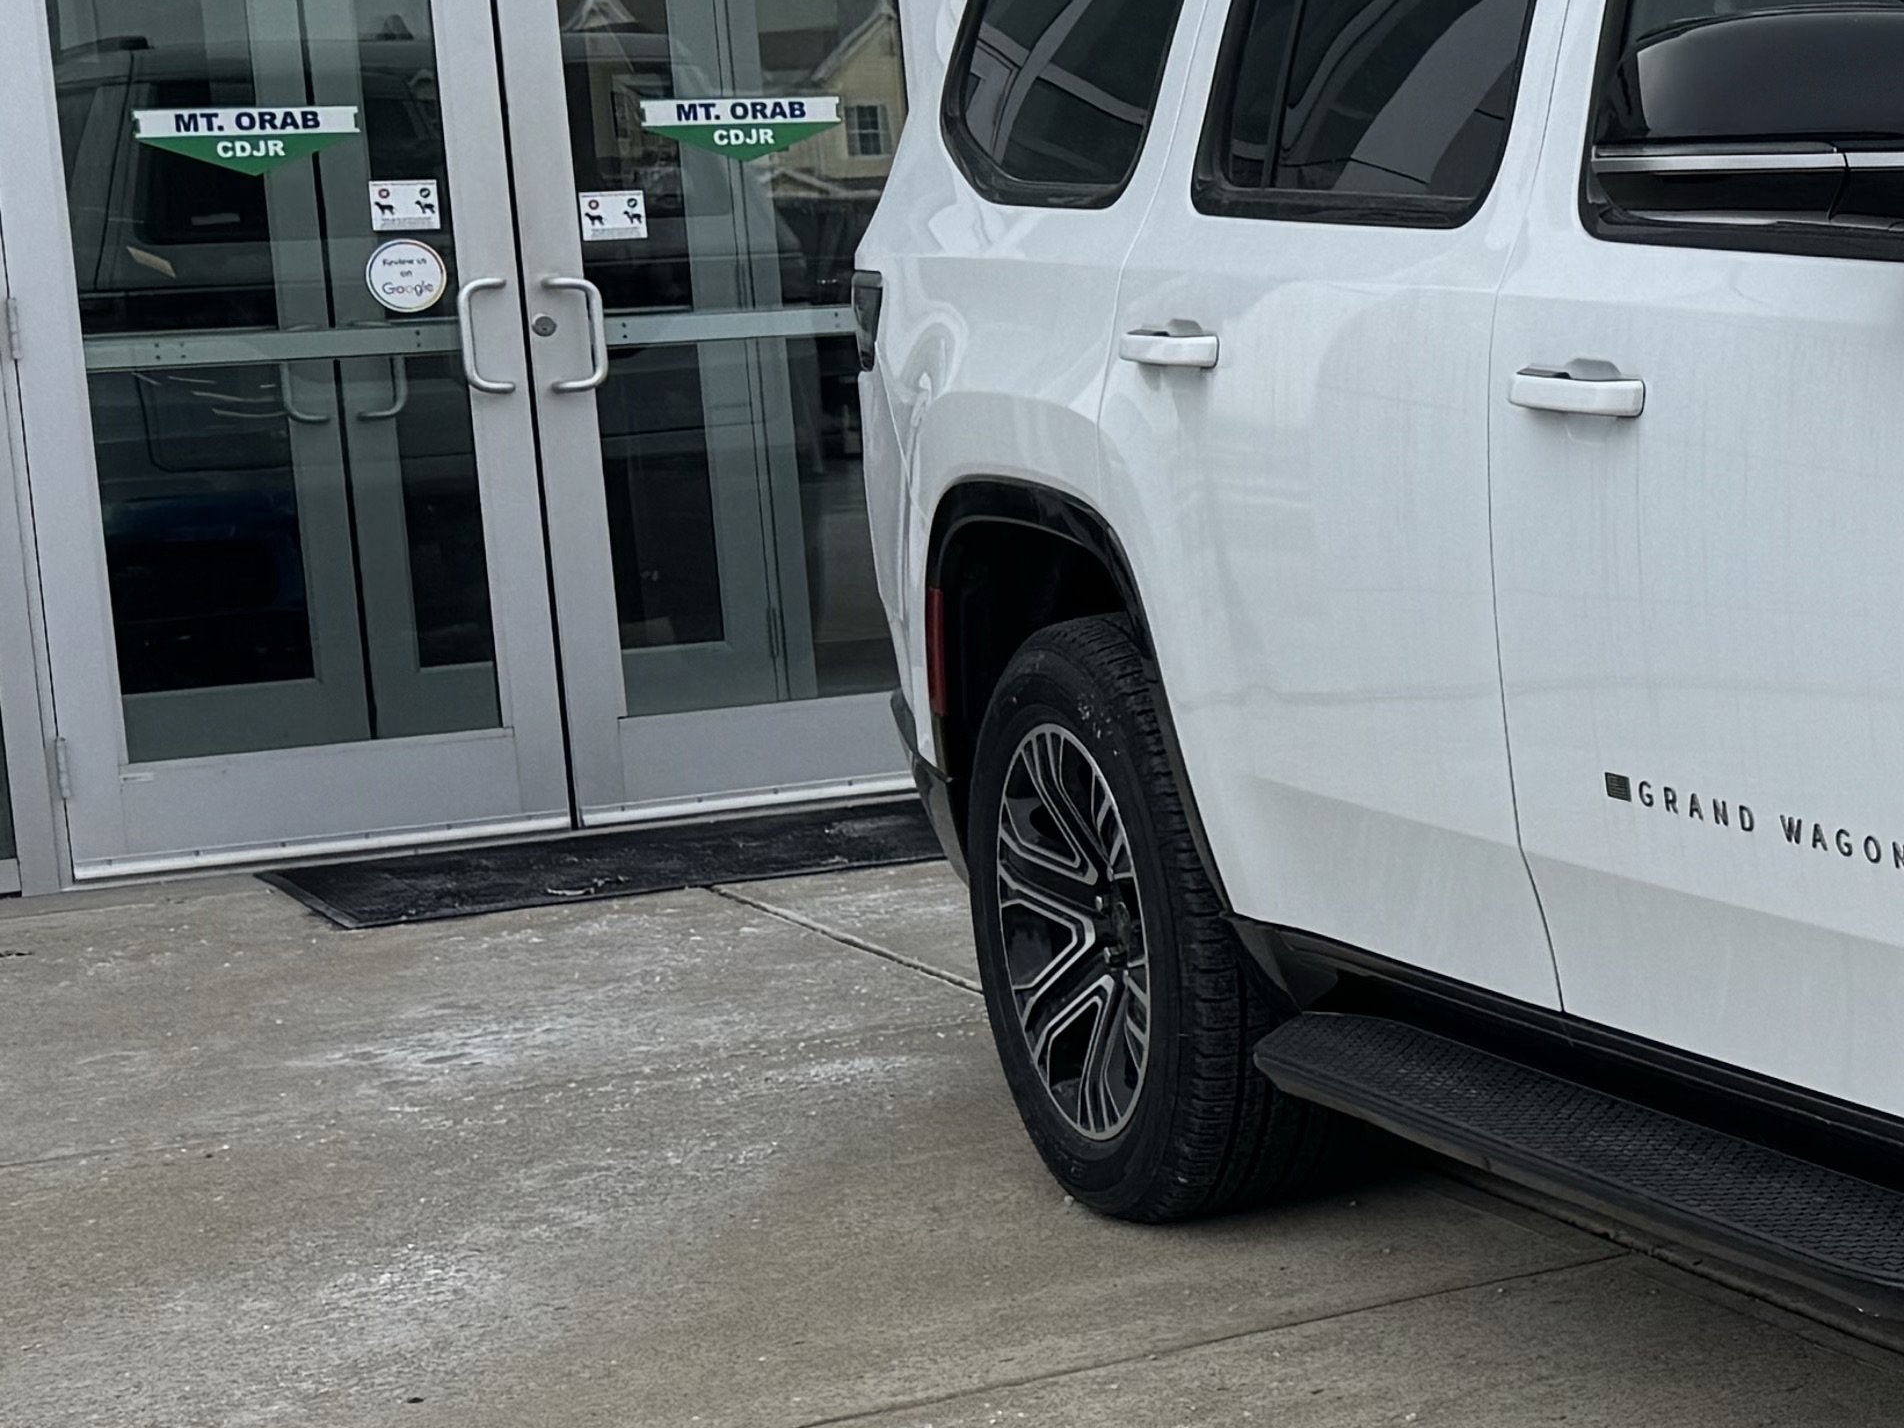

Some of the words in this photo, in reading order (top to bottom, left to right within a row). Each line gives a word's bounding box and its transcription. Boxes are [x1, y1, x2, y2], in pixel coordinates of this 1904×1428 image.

[174, 112, 225, 133] MT.
[234, 110, 322, 132] ORAB
[675, 102, 721, 122] MT.
[729, 101, 807, 120] ORAB
[712, 128, 775, 146] CDJR
[215, 139, 286, 159] CDJR
[382, 258, 414, 267] Review
[382, 281, 434, 297] Google
[1637, 780, 1756, 834] GRAND
